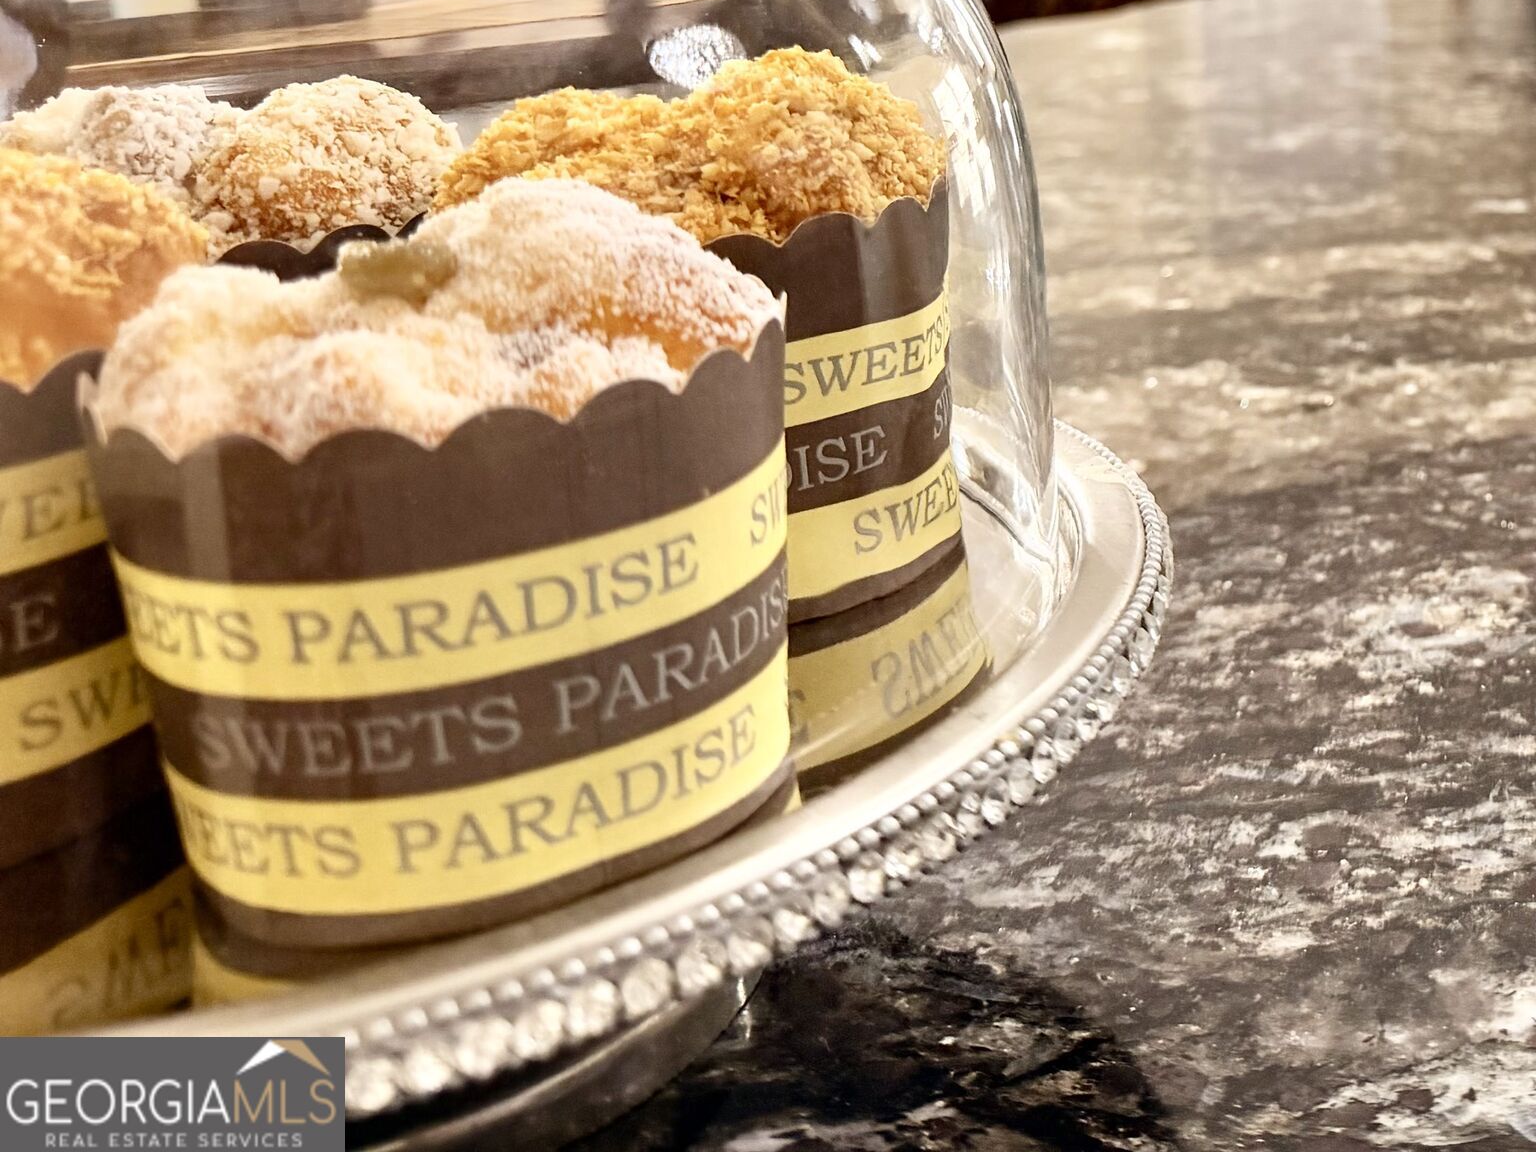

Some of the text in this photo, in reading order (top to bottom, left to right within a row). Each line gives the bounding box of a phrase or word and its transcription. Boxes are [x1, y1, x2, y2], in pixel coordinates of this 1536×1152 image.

[783, 314, 944, 405] SWEETS
[786, 425, 888, 491] ISE
[281, 532, 701, 666] PARADISE
[194, 694, 523, 779] SWEETS
[182, 800, 362, 879] EETS
[389, 703, 758, 875] PARADISE
